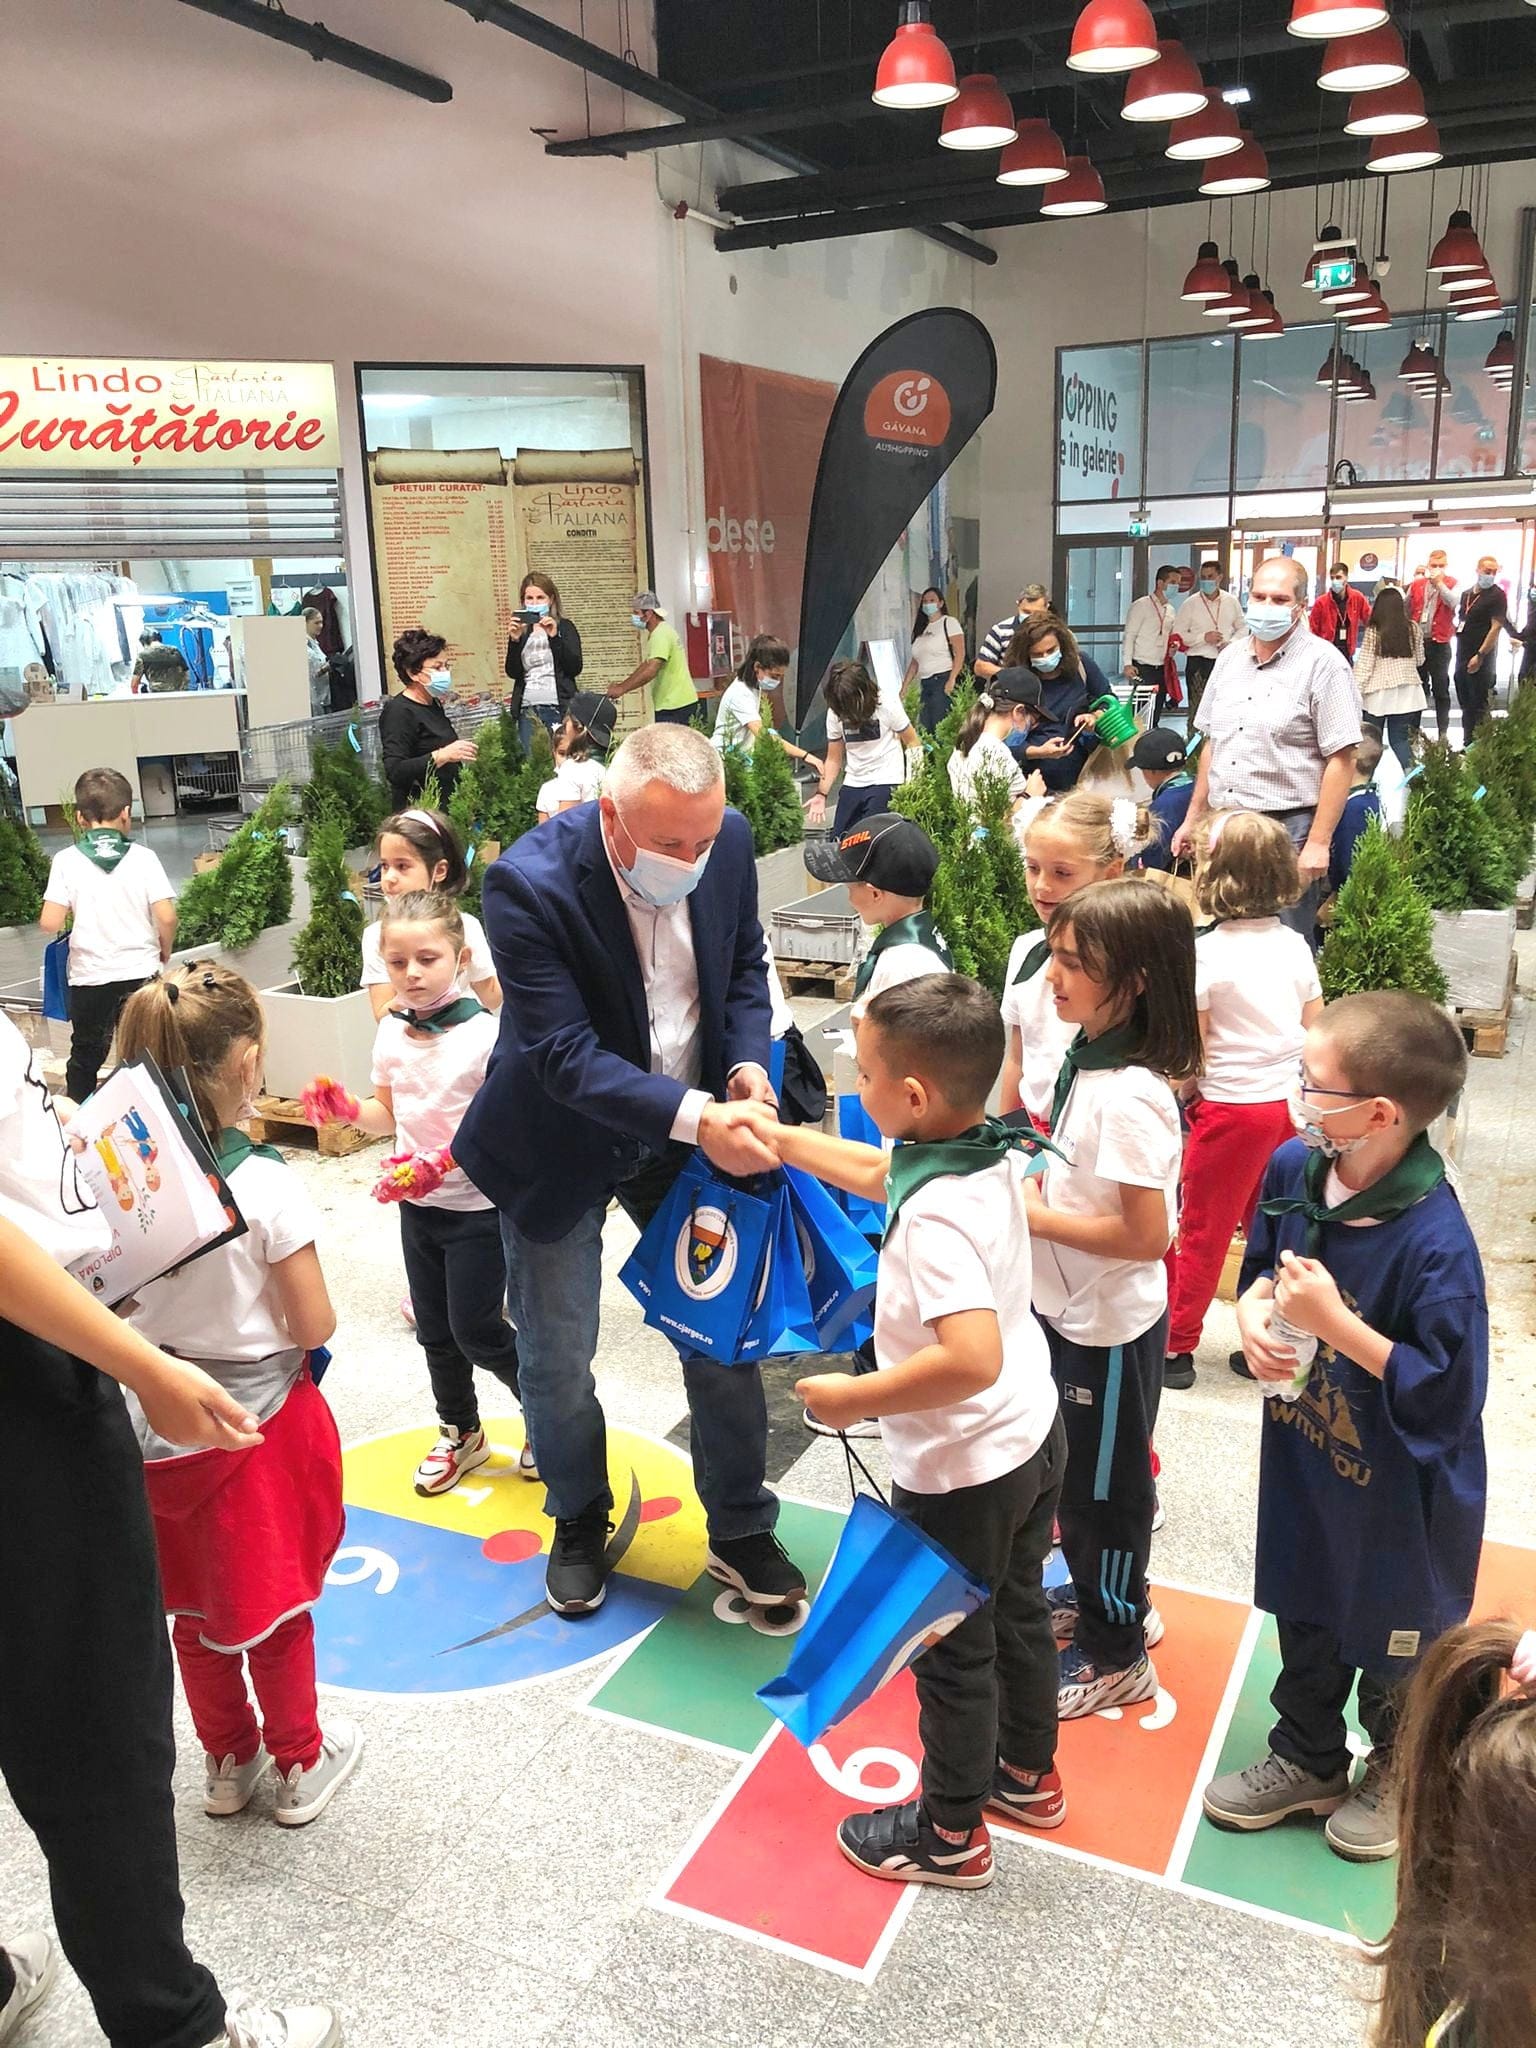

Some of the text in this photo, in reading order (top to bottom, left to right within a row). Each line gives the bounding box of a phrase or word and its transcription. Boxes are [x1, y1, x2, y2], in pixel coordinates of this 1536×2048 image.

[32, 366, 163, 393] Lindo
[392, 483, 436, 493] PRETURI
[564, 484, 622, 495] Lindo
[840, 830, 872, 852] STIHL
[78, 1245, 123, 1281] DIPLOMA
[1268, 1400, 1326, 1450] WITH
